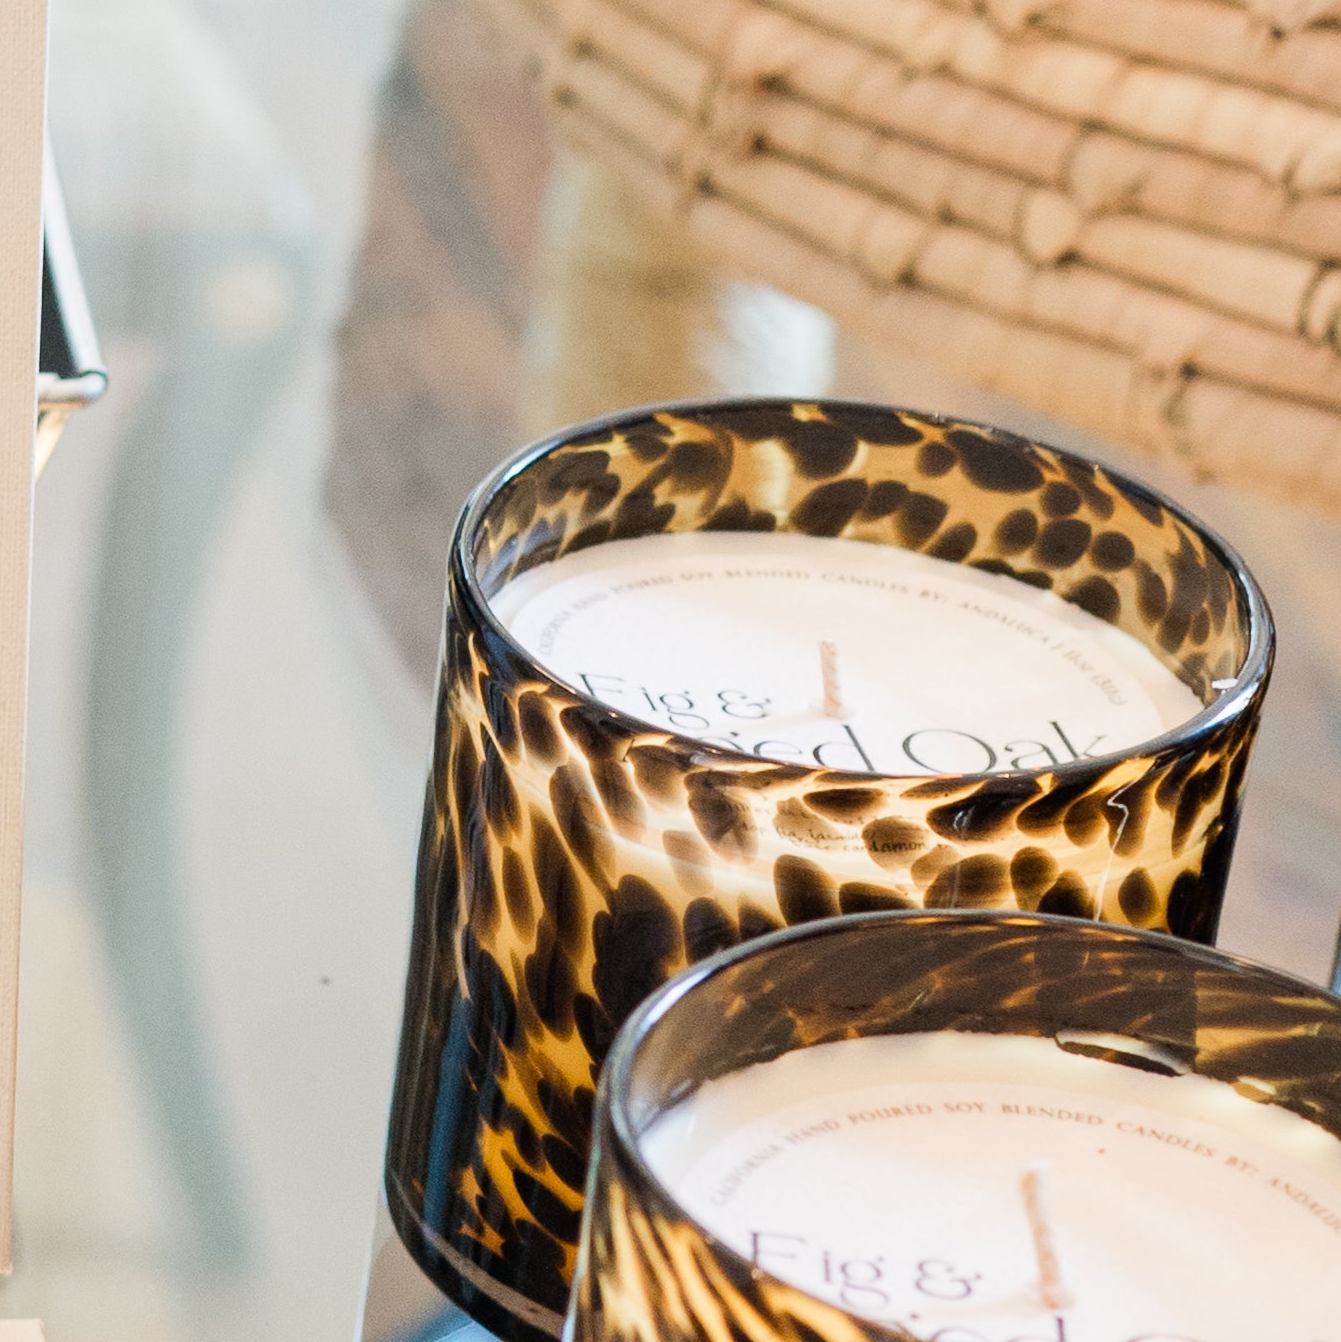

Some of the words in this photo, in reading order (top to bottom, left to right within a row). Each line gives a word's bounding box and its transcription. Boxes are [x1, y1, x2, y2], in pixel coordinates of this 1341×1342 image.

[578, 671, 711, 730] Fig
[717, 689, 772, 719] &
[902, 720, 1108, 774] Oak
[846, 1102, 933, 1125] POURED
[943, 1101, 986, 1115] SOY
[1001, 1102, 1104, 1126] BLENDED
[1116, 1120, 1217, 1159] CANDLES
[749, 1230, 892, 1311] Fig
[914, 1258, 983, 1301] &
